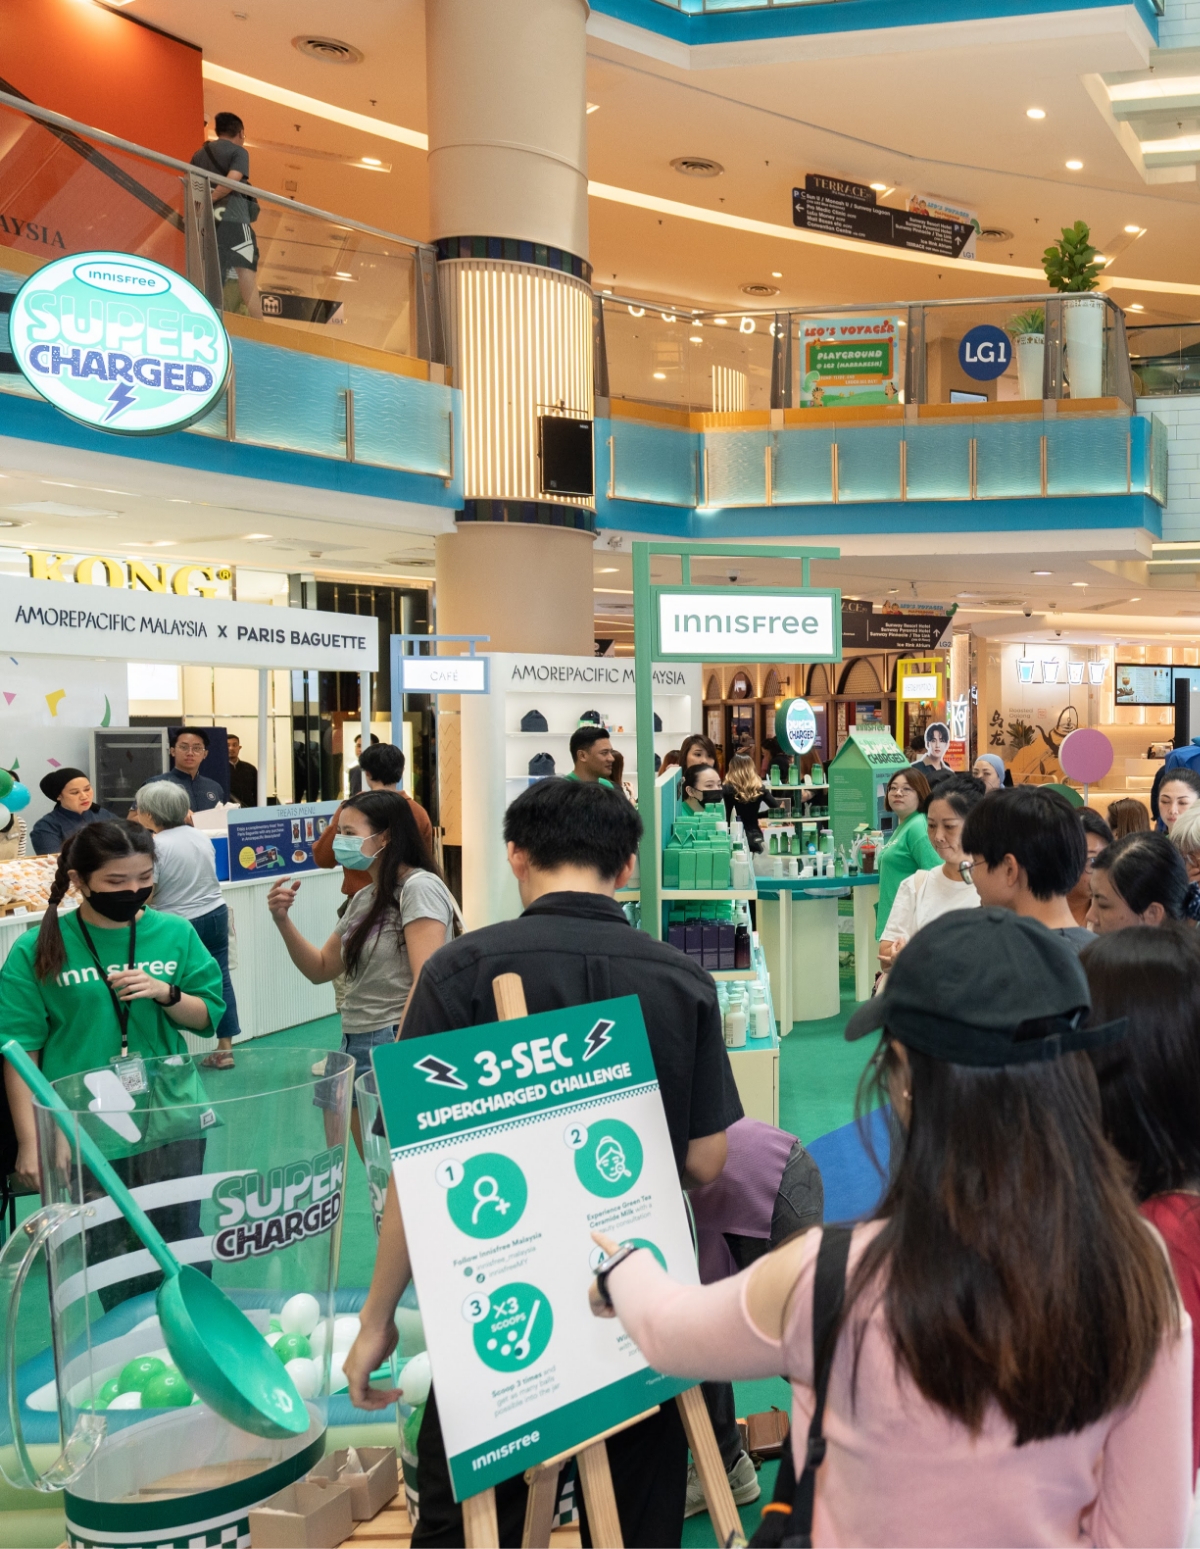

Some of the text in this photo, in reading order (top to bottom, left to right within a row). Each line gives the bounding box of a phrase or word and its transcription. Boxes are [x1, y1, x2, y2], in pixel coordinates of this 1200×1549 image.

[813, 177, 867, 198] TERRACE
[963, 251, 975, 259] LG1
[28, 291, 217, 362] SUPER
[804, 323, 895, 337] LEO'S VOYAGER
[817, 350, 883, 360] PLAYGROUND
[965, 341, 1007, 363] LG1
[28, 344, 214, 393] CHARGED
[15, 605, 136, 632] AMOREPACIFIC
[140, 617, 208, 638] MALAYSIA
[237, 626, 286, 644] PARIS
[290, 631, 367, 650] BAGUETTE
[430, 669, 459, 682] CAFÉ
[511, 664, 686, 685] AMOREPACIFIC MAYSIA
[788, 730, 814, 740] CHARGED
[866, 752, 906, 765] CHARGED
[276, 807, 298, 818] TREATS
[473, 1033, 574, 1087] 3-SEC
[416, 1062, 633, 1131] SUPERCHARGED CHALLENGE
[570, 1128, 582, 1144] 2
[444, 1166, 455, 1182] 1
[211, 1145, 345, 1229] SUPER
[587, 1194, 652, 1221] Experience Green Tea
[213, 1191, 342, 1261] CHARGED
[589, 1214, 620, 1228] Ceramide
[620, 1209, 634, 1218] Milk
[616, 1211, 651, 1228] consultation
[453, 1254, 478, 1268] Follow
[511, 1231, 542, 1247] Malaysia
[470, 1299, 483, 1317] 3
[490, 1311, 527, 1333] SCOOPS
[491, 1384, 515, 1398] Scoop
[522, 1372, 542, 1385] times
[543, 1365, 556, 1376] and
